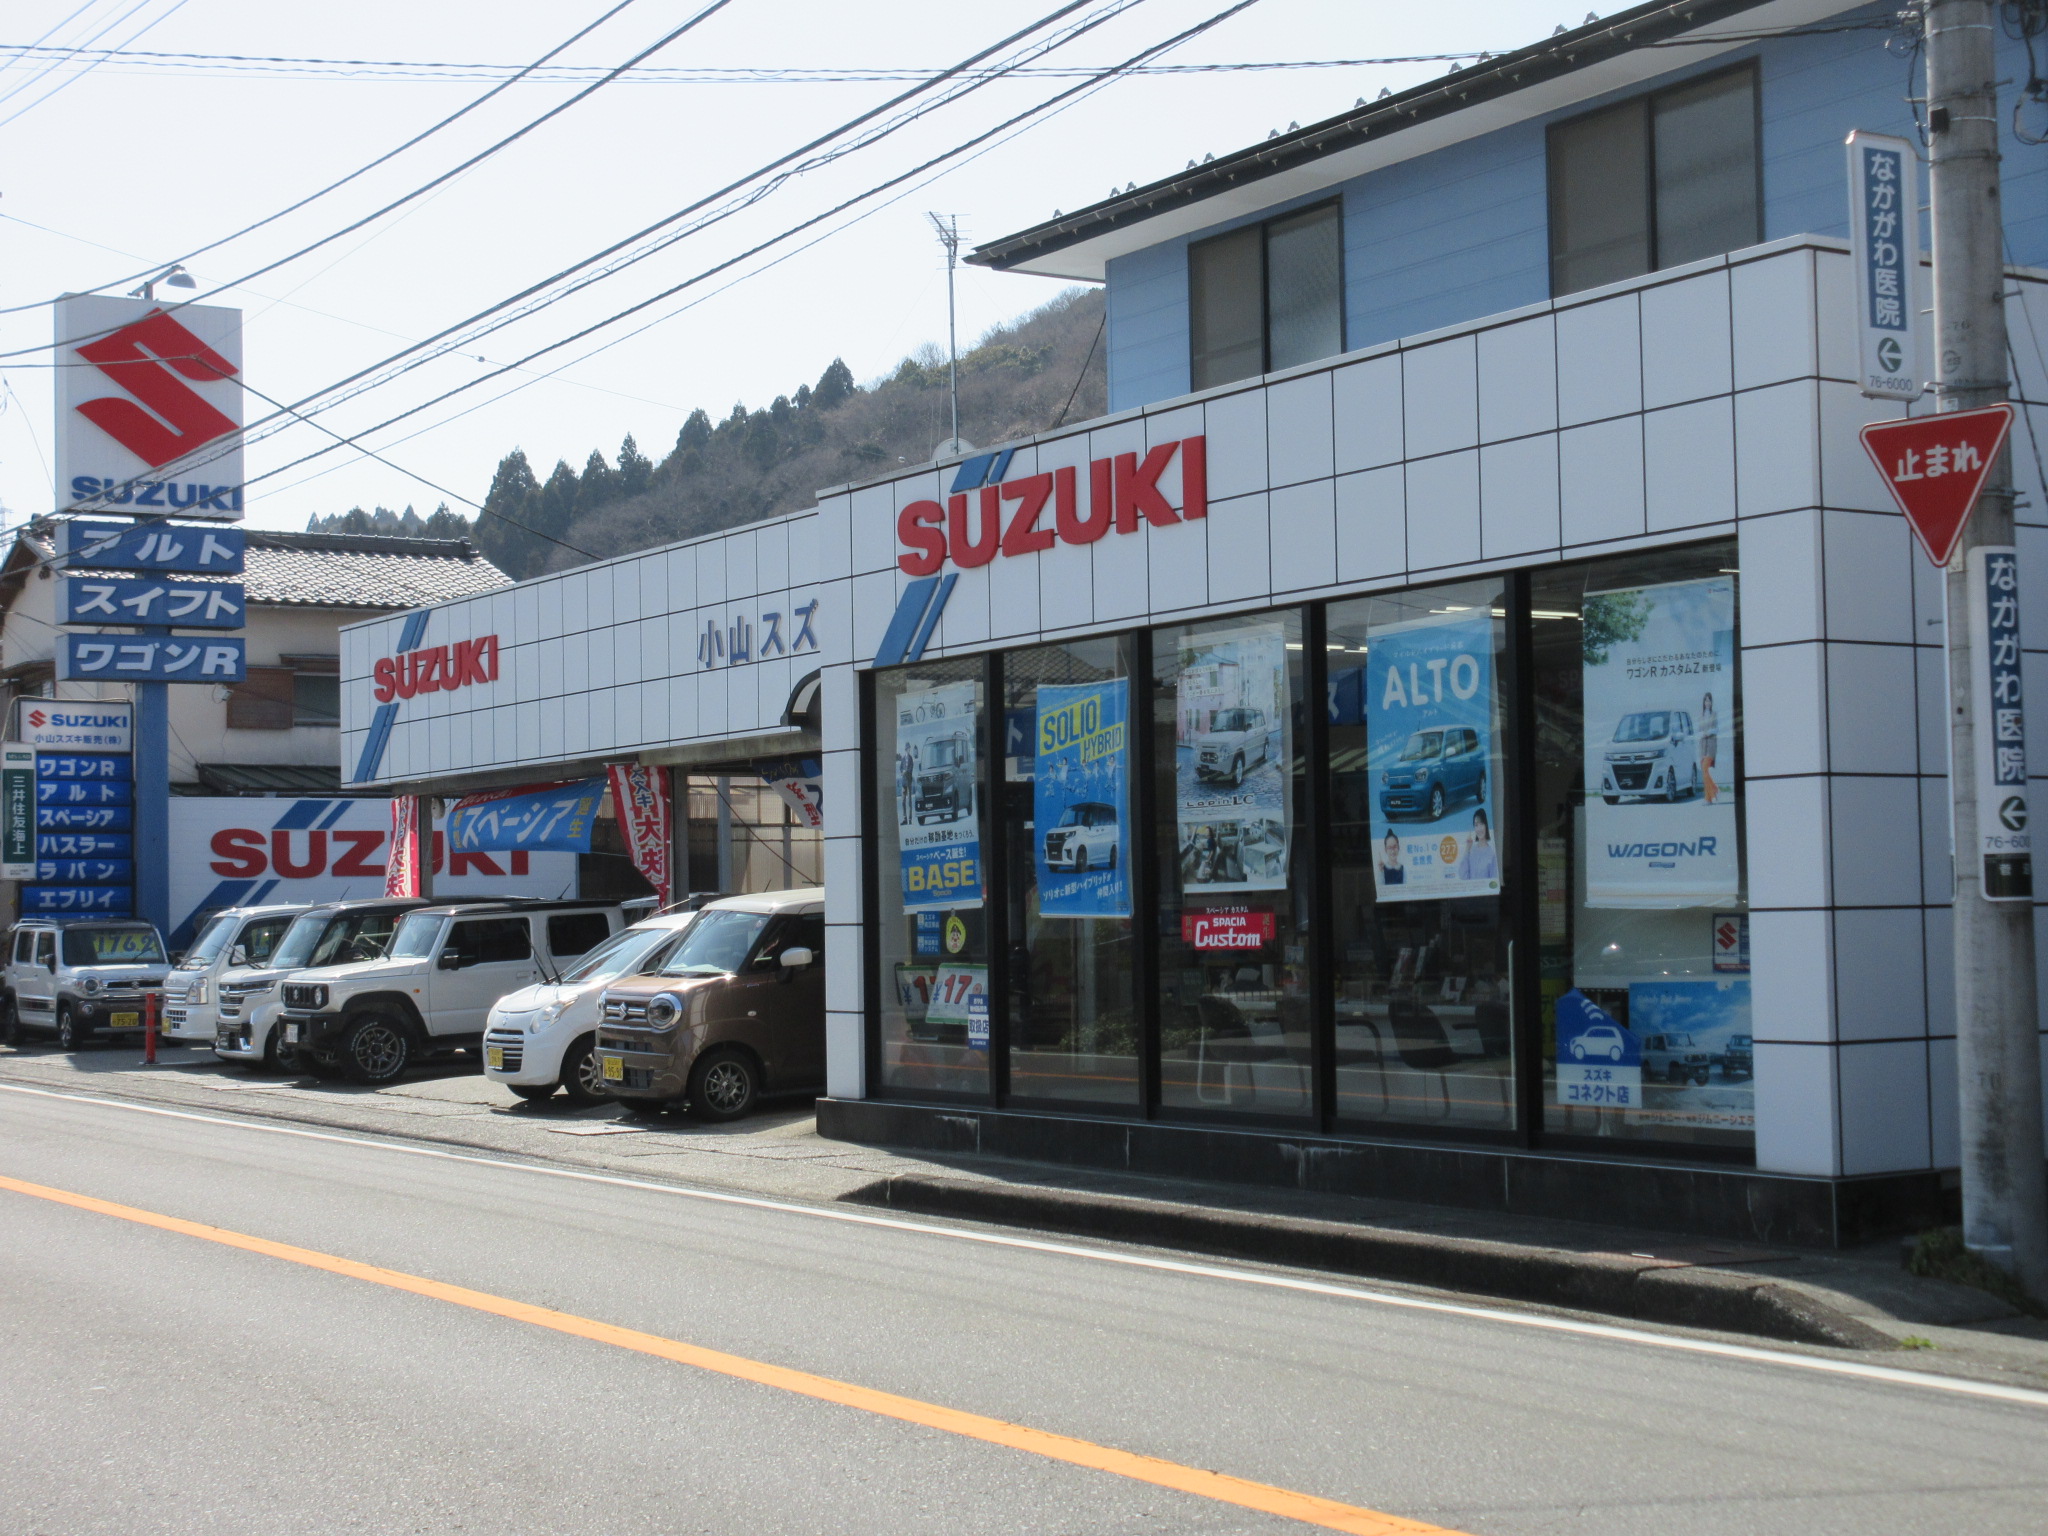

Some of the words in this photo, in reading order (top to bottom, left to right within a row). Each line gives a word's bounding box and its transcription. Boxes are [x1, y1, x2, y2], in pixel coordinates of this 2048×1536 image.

[1870, 153, 1901, 328] なかがわ医院
[1869, 374, 1914, 391] 76-6000
[1894, 440, 1983, 482] 止まれ
[71, 475, 242, 512] SUZUKI
[897, 435, 1207, 577] SUZUKI
[75, 528, 236, 565] アルト
[75, 583, 240, 620] スイフト
[75, 642, 239, 676] ワゴンR
[374, 634, 500, 703] SUZUKI
[1626, 666, 1658, 680] ワゴンR
[1660, 662, 1700, 677] カスタムZ
[1989, 557, 2026, 782] なかがわ医院
[1382, 654, 1480, 711] ALTO
[51, 714, 128, 727] SUZUKI
[1043, 699, 1097, 751] SOLIO
[1083, 726, 1122, 763] HYBRID
[39, 759, 115, 776] ワゴンR
[40, 785, 115, 801] アルト
[12, 776, 26, 854] 三井住友海上
[39, 810, 115, 827] スペーシア
[462, 798, 579, 849] スペーシア
[40, 836, 115, 852] ハスラー
[39, 863, 115, 880] ラパン
[908, 860, 975, 892] BASE
[39, 891, 114, 908] エブリイ
[1195, 920, 1262, 947] Custom
[1213, 917, 1247, 928] SPACIA
[1584, 1069, 1612, 1082] スズキ
[1568, 1085, 1630, 1104] コネクト店
